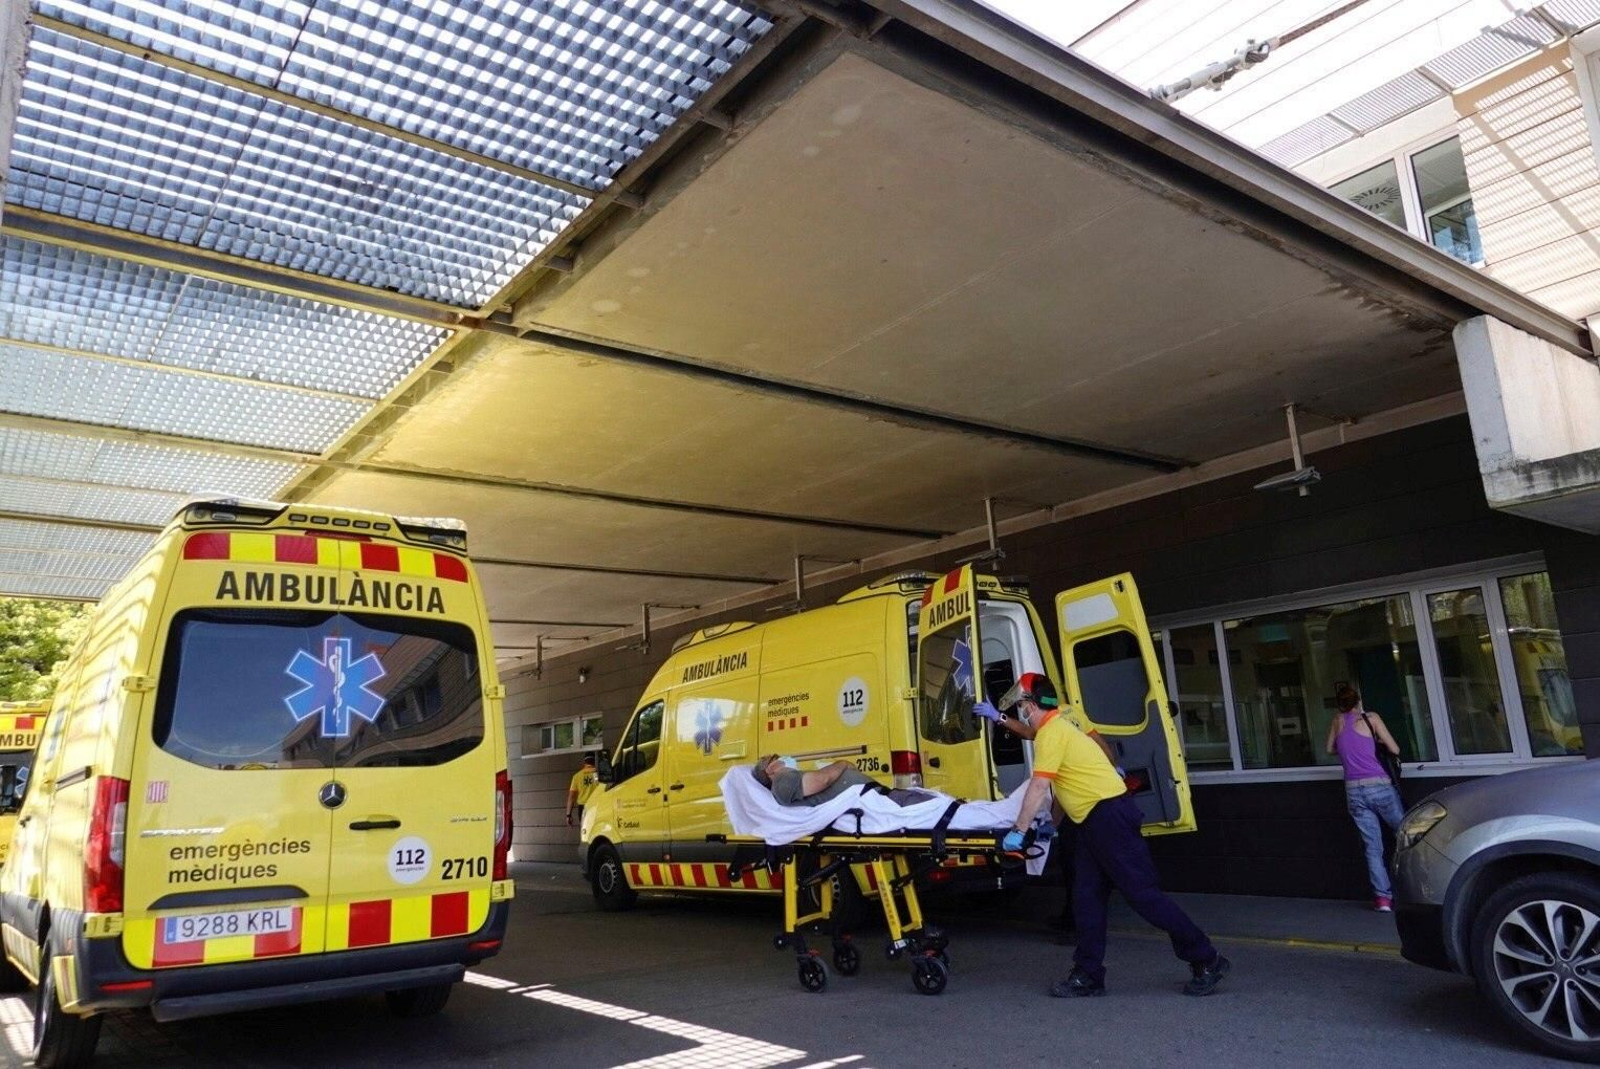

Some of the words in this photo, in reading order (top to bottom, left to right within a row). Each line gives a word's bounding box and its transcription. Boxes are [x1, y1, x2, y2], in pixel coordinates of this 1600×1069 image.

[216, 571, 445, 614] AMBULÀNCIA
[929, 591, 971, 629] AMBUL
[682, 652, 747, 684] AMBULÀNCIA
[843, 689, 863, 708] 112
[856, 757, 879, 772] 2736
[170, 838, 311, 861] emergències
[396, 849, 425, 866] 112
[168, 863, 277, 883] mèdiques
[441, 856, 488, 880] 2710
[182, 914, 239, 938] 9288
[247, 911, 287, 933] KRL
